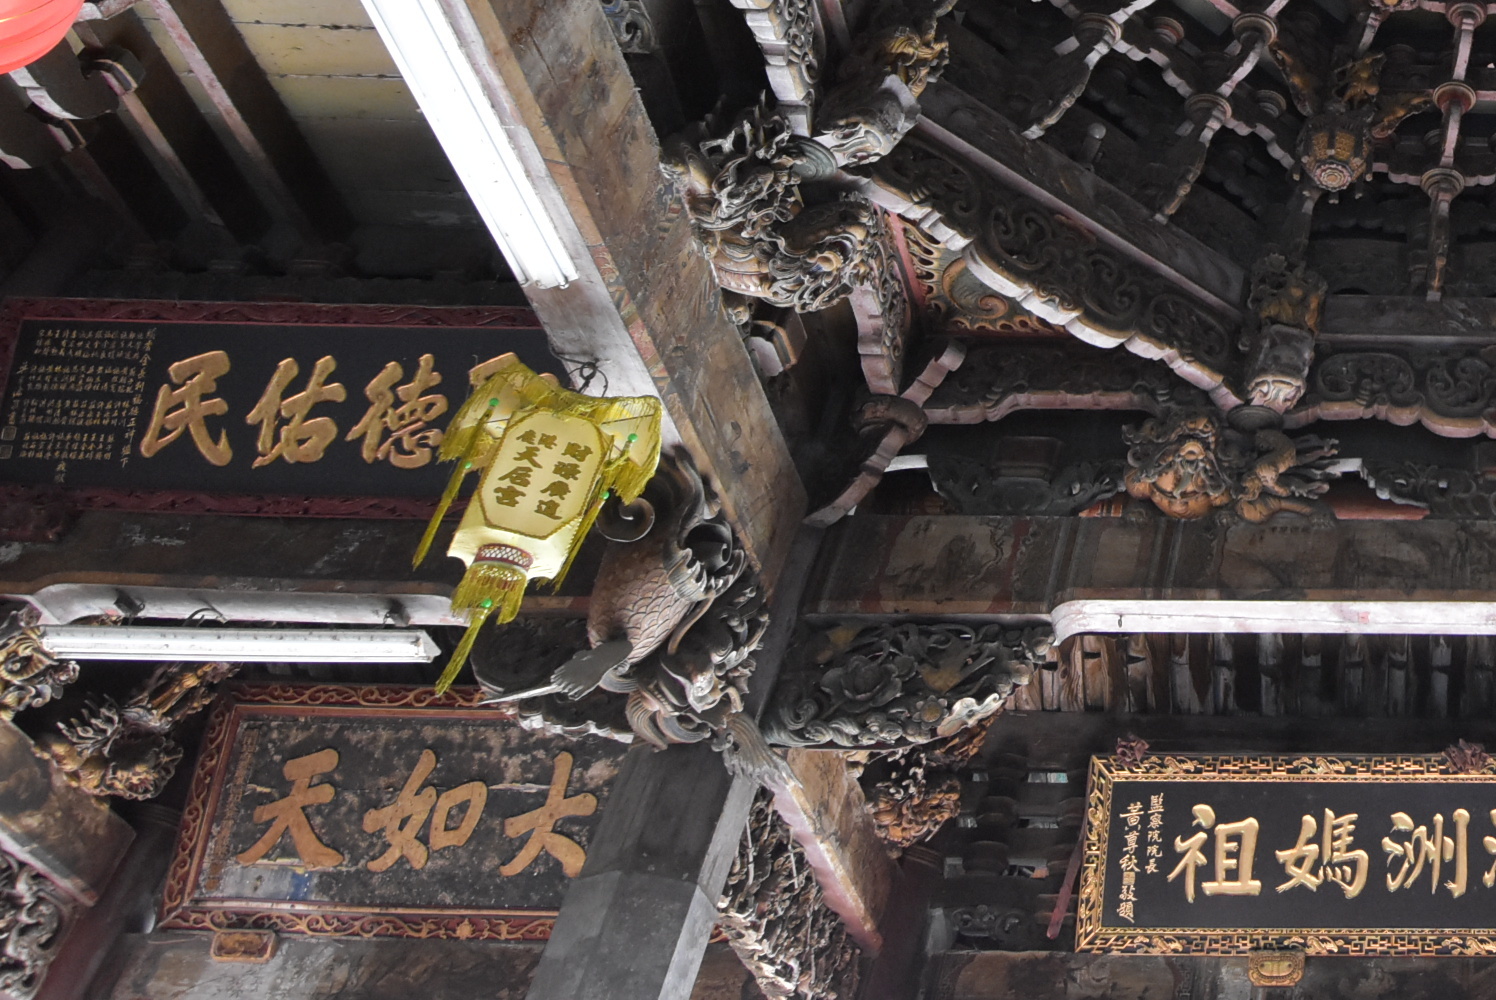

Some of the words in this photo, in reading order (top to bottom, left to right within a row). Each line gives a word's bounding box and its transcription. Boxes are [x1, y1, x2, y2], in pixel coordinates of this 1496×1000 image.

[141, 350, 560, 469] 德佑民
[493, 446, 543, 507] 天后宮
[237, 749, 597, 877] 大如天
[1145, 793, 1165, 874] 監察院院長
